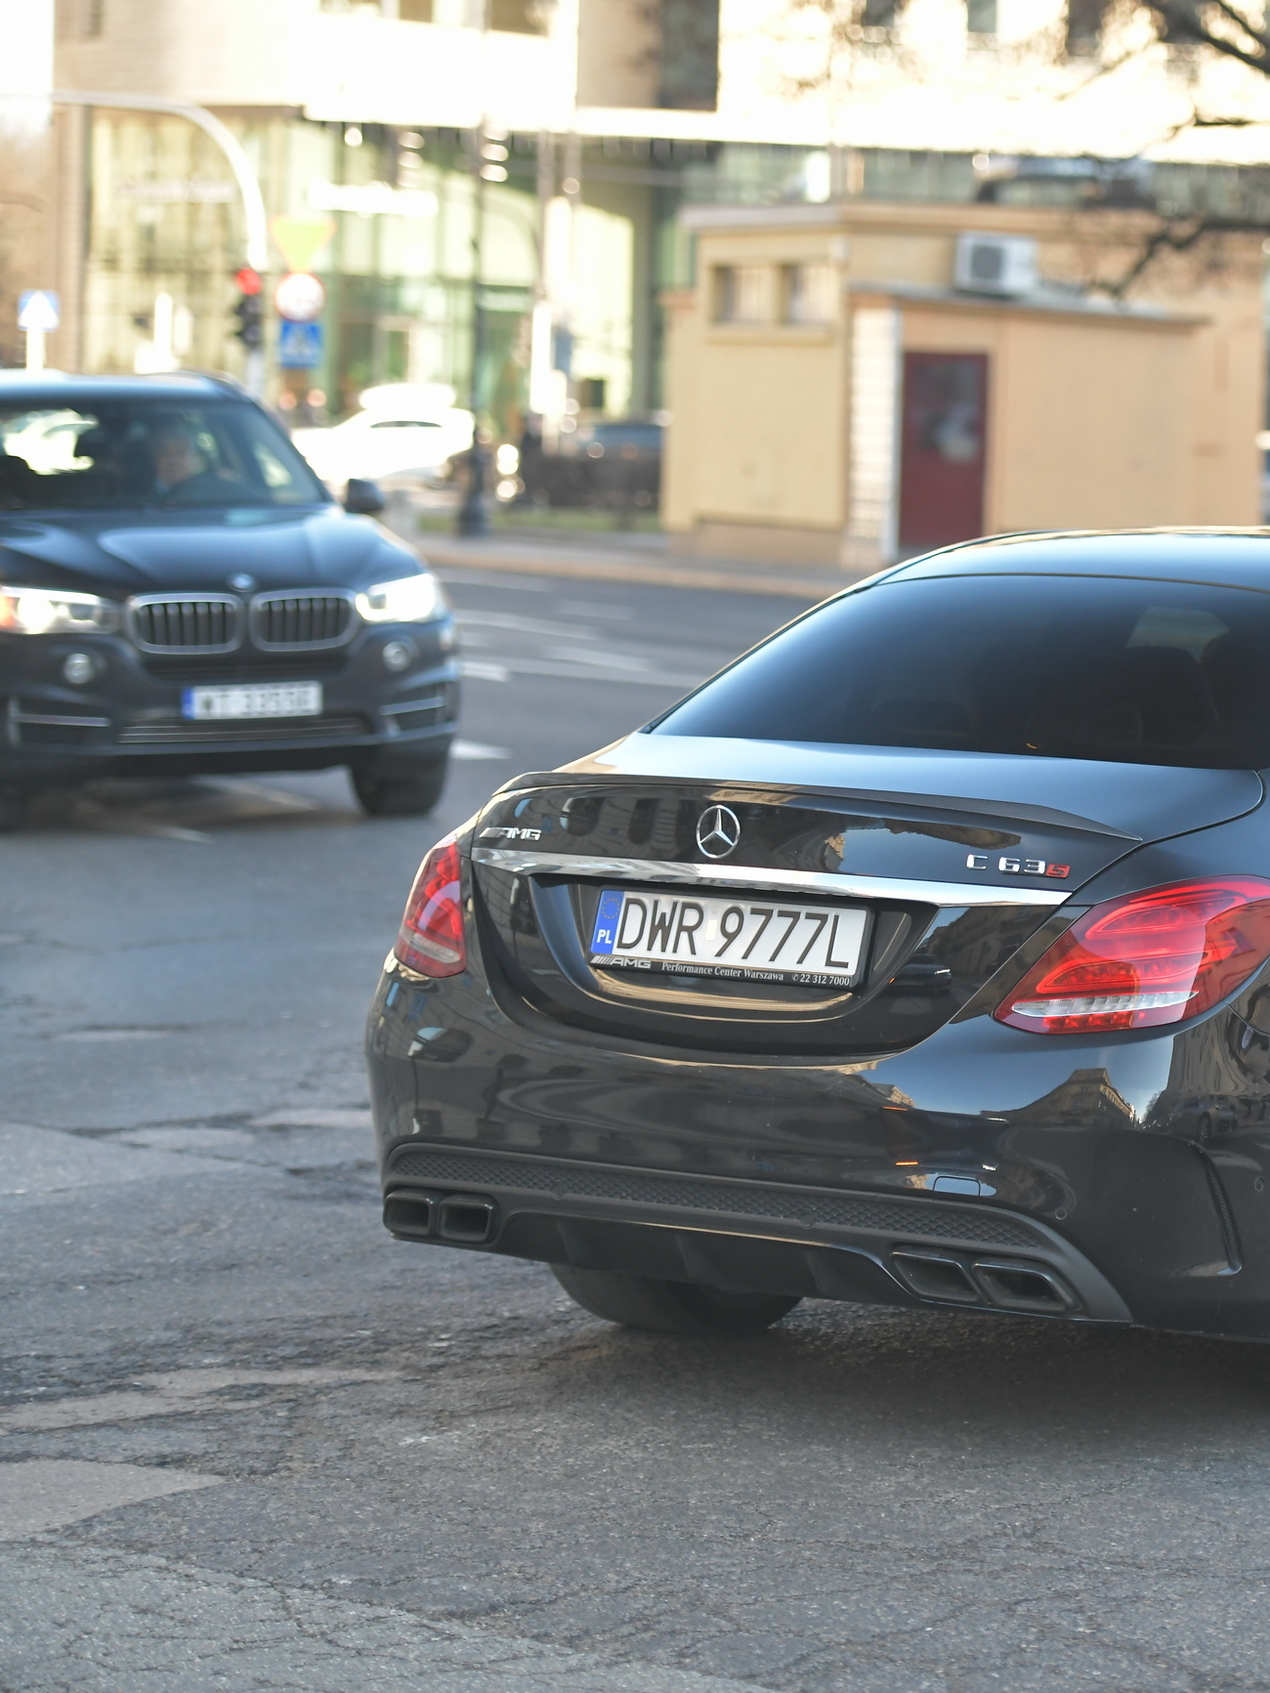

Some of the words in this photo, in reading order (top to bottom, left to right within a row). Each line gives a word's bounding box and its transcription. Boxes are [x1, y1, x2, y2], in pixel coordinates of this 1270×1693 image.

[966, 854, 988, 870] C
[597, 929, 613, 944] PL
[617, 897, 704, 955] DWR
[714, 906, 849, 968] 9777L
[609, 956, 651, 969] AMG
[661, 961, 713, 975] Performance
[714, 966, 742, 977] Center
[743, 968, 784, 980] Warszawa
[800, 973, 810, 983] 22
[812, 974, 827, 985] 312
[829, 976, 850, 986] 7000
